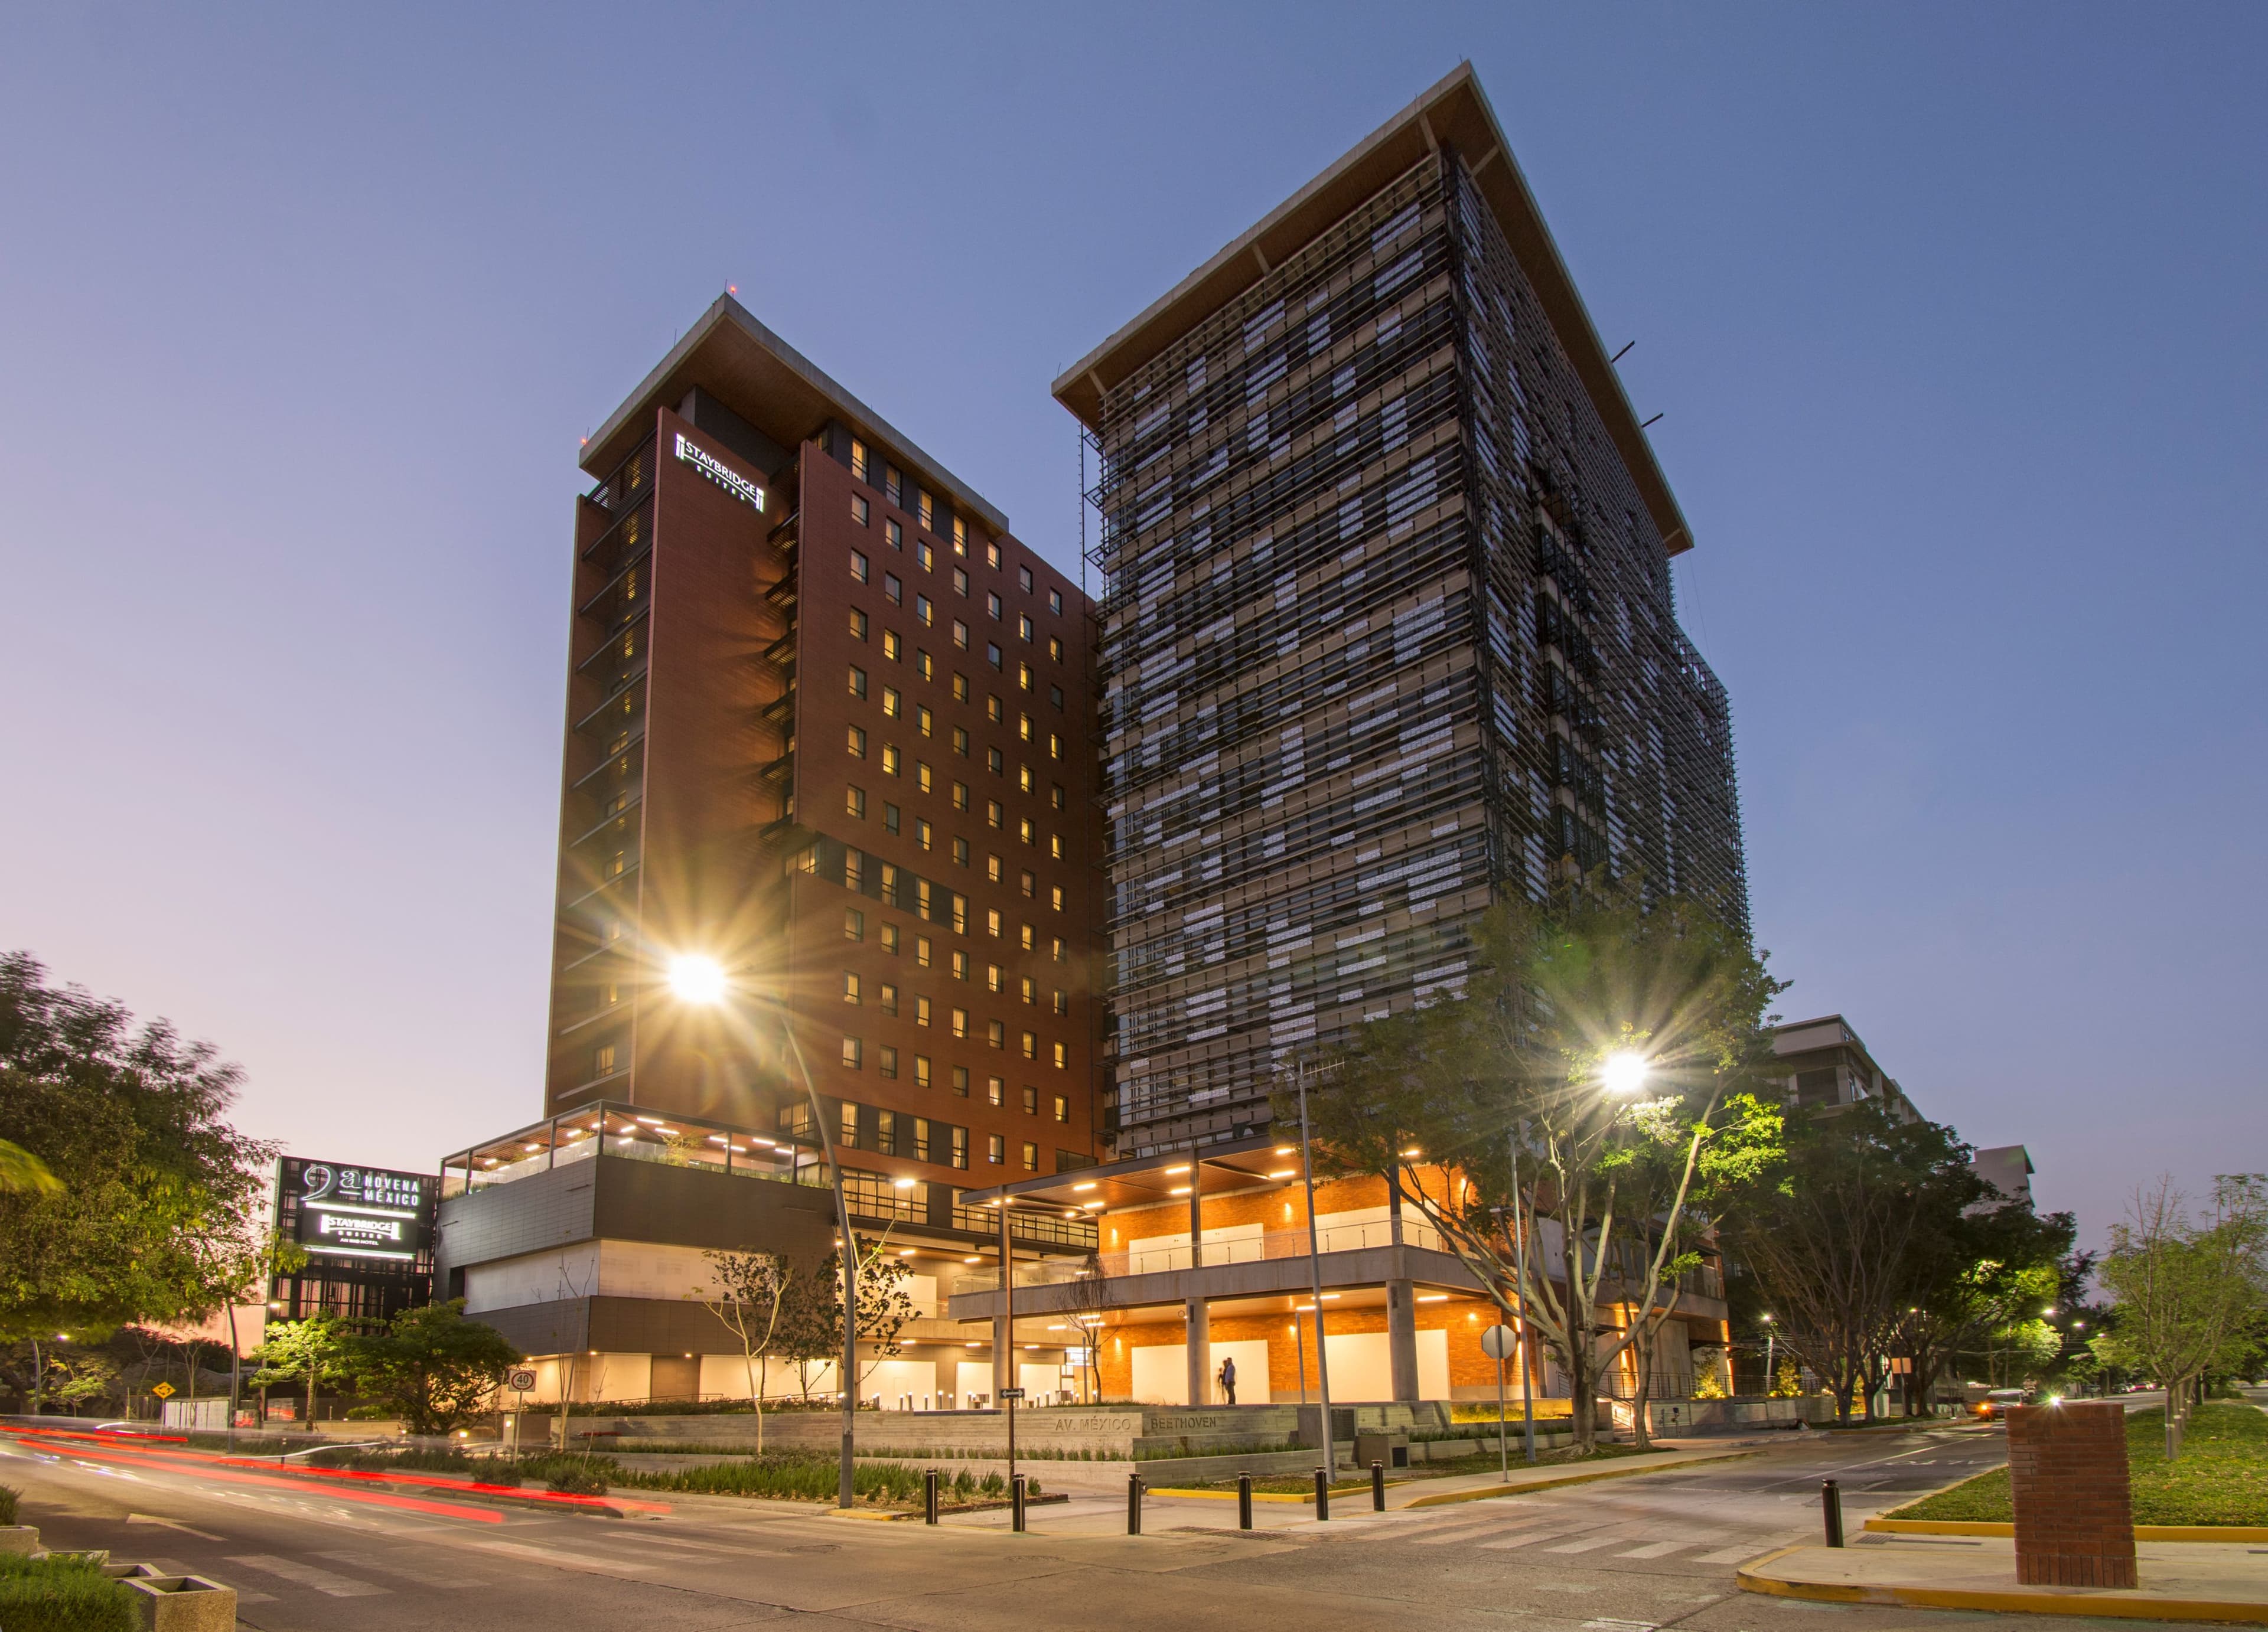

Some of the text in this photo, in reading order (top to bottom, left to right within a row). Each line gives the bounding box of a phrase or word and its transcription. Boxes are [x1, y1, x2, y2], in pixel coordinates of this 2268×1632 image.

[686, 442, 755, 497] STAYBRIDGE
[696, 465, 745, 501] SUITES
[364, 1175, 419, 1193] NOVENA
[364, 1189, 419, 1206] MÉXICO
[330, 1217, 392, 1231] STAYBRIDGE
[517, 1375, 529, 1383] 40
[1055, 1415, 1131, 1431] AV. MÉXICO
[1151, 1417, 1217, 1429] BEETHOVEN
